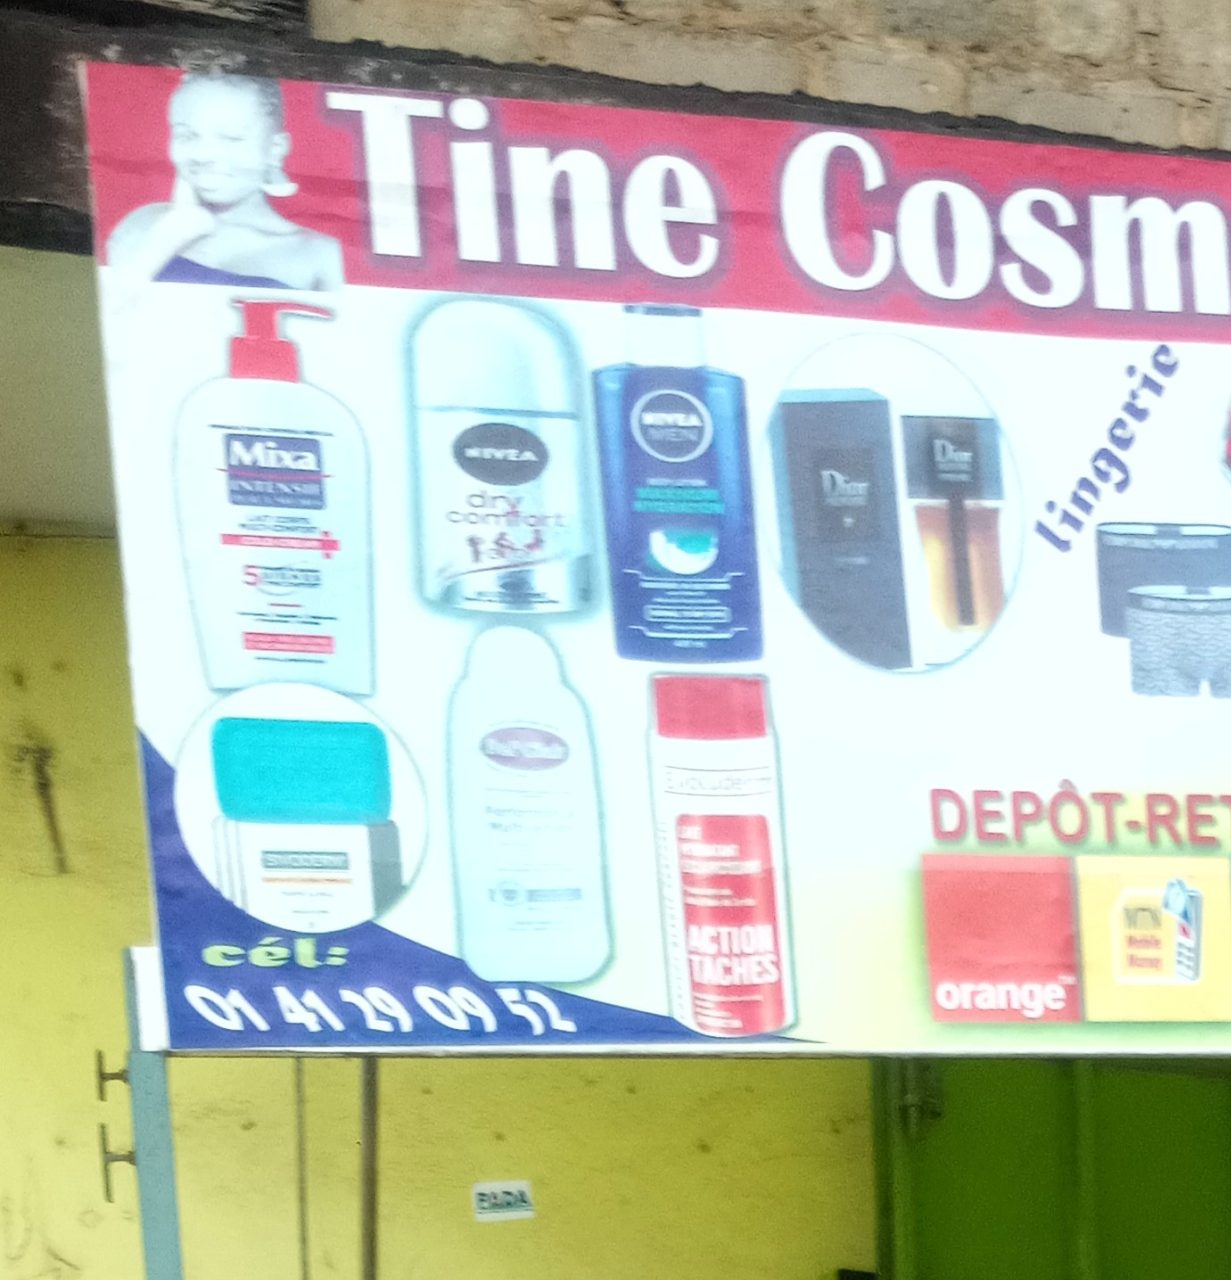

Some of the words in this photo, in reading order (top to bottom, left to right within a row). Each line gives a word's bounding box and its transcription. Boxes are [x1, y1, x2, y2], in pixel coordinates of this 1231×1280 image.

[325, 90, 720, 279] Tine
[229, 440, 321, 471] Mixa
[463, 447, 539, 462] NIVEA
[1034, 344, 1180, 552] lingerie
[446, 507, 567, 528] comfort
[466, 489, 524, 516] dry
[202, 937, 350, 969] cél:
[685, 924, 774, 955] ACTION
[687, 954, 780, 986] TACHES
[183, 984, 271, 1032] 01
[272, 985, 346, 1033] 41
[338, 985, 414, 1033] 29
[412, 985, 498, 1034] 09
[494, 987, 578, 1037] 52
[935, 979, 1068, 1019] orange
